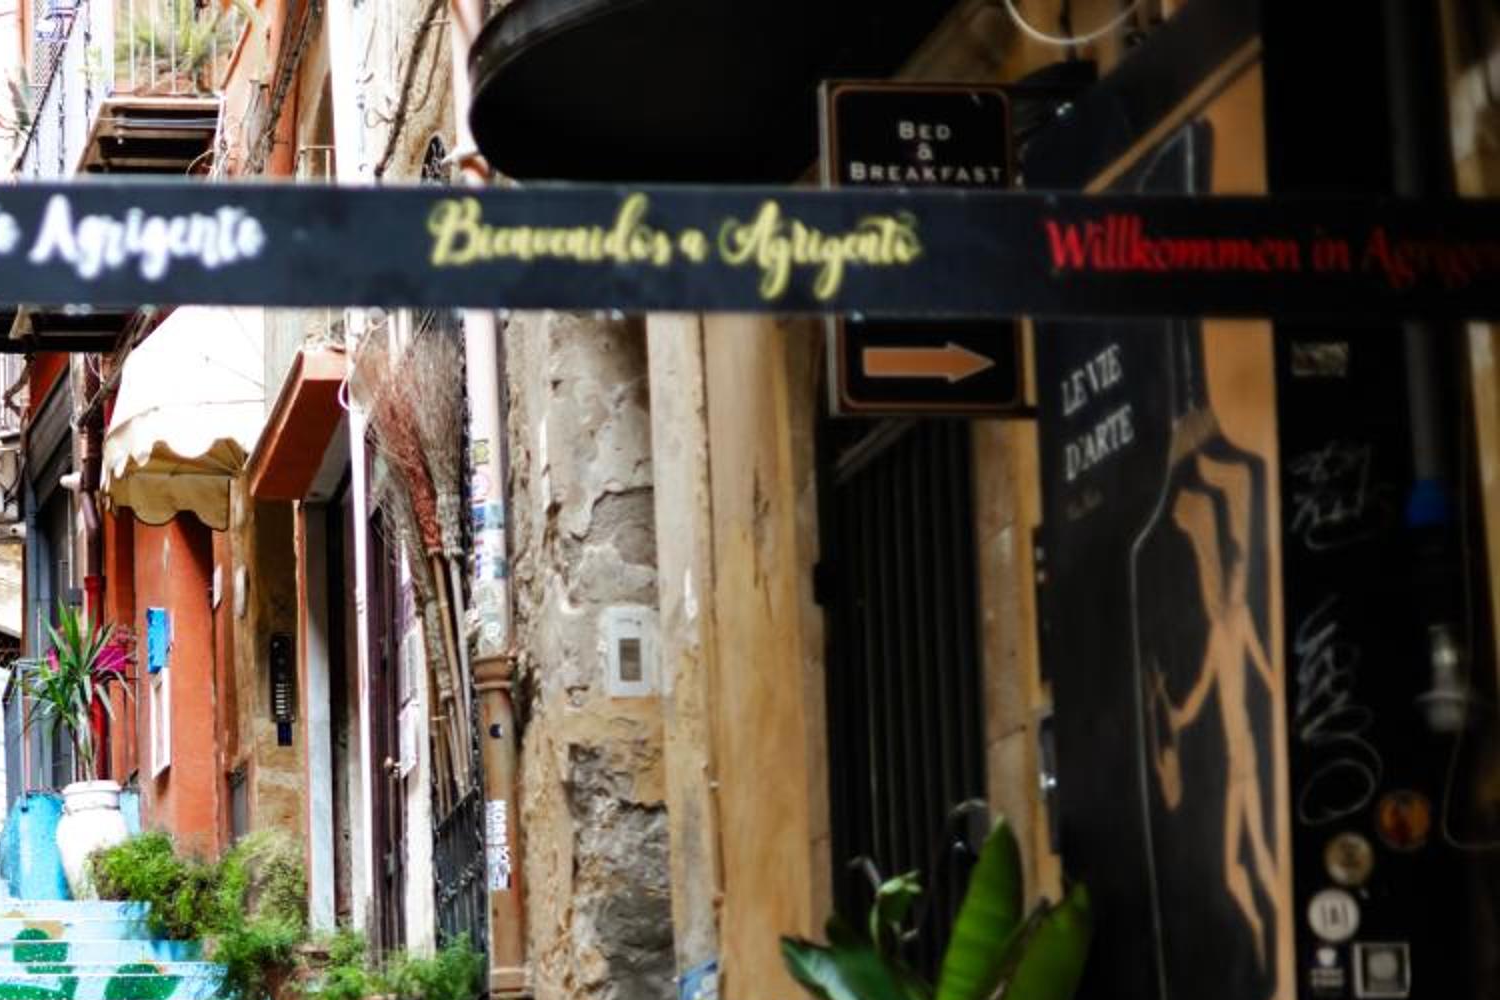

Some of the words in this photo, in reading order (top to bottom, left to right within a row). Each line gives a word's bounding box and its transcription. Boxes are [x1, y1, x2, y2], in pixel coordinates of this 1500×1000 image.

[898, 119, 951, 141] BED
[917, 143, 933, 161] &
[849, 160, 1002, 182] BREAKFAST
[29, 194, 266, 281] Agrigento
[427, 192, 670, 266] Bienvenidos
[680, 228, 707, 264] a
[718, 199, 922, 300] Agrigento
[1043, 210, 1303, 276] Willkommen
[1310, 222, 1351, 273] in
